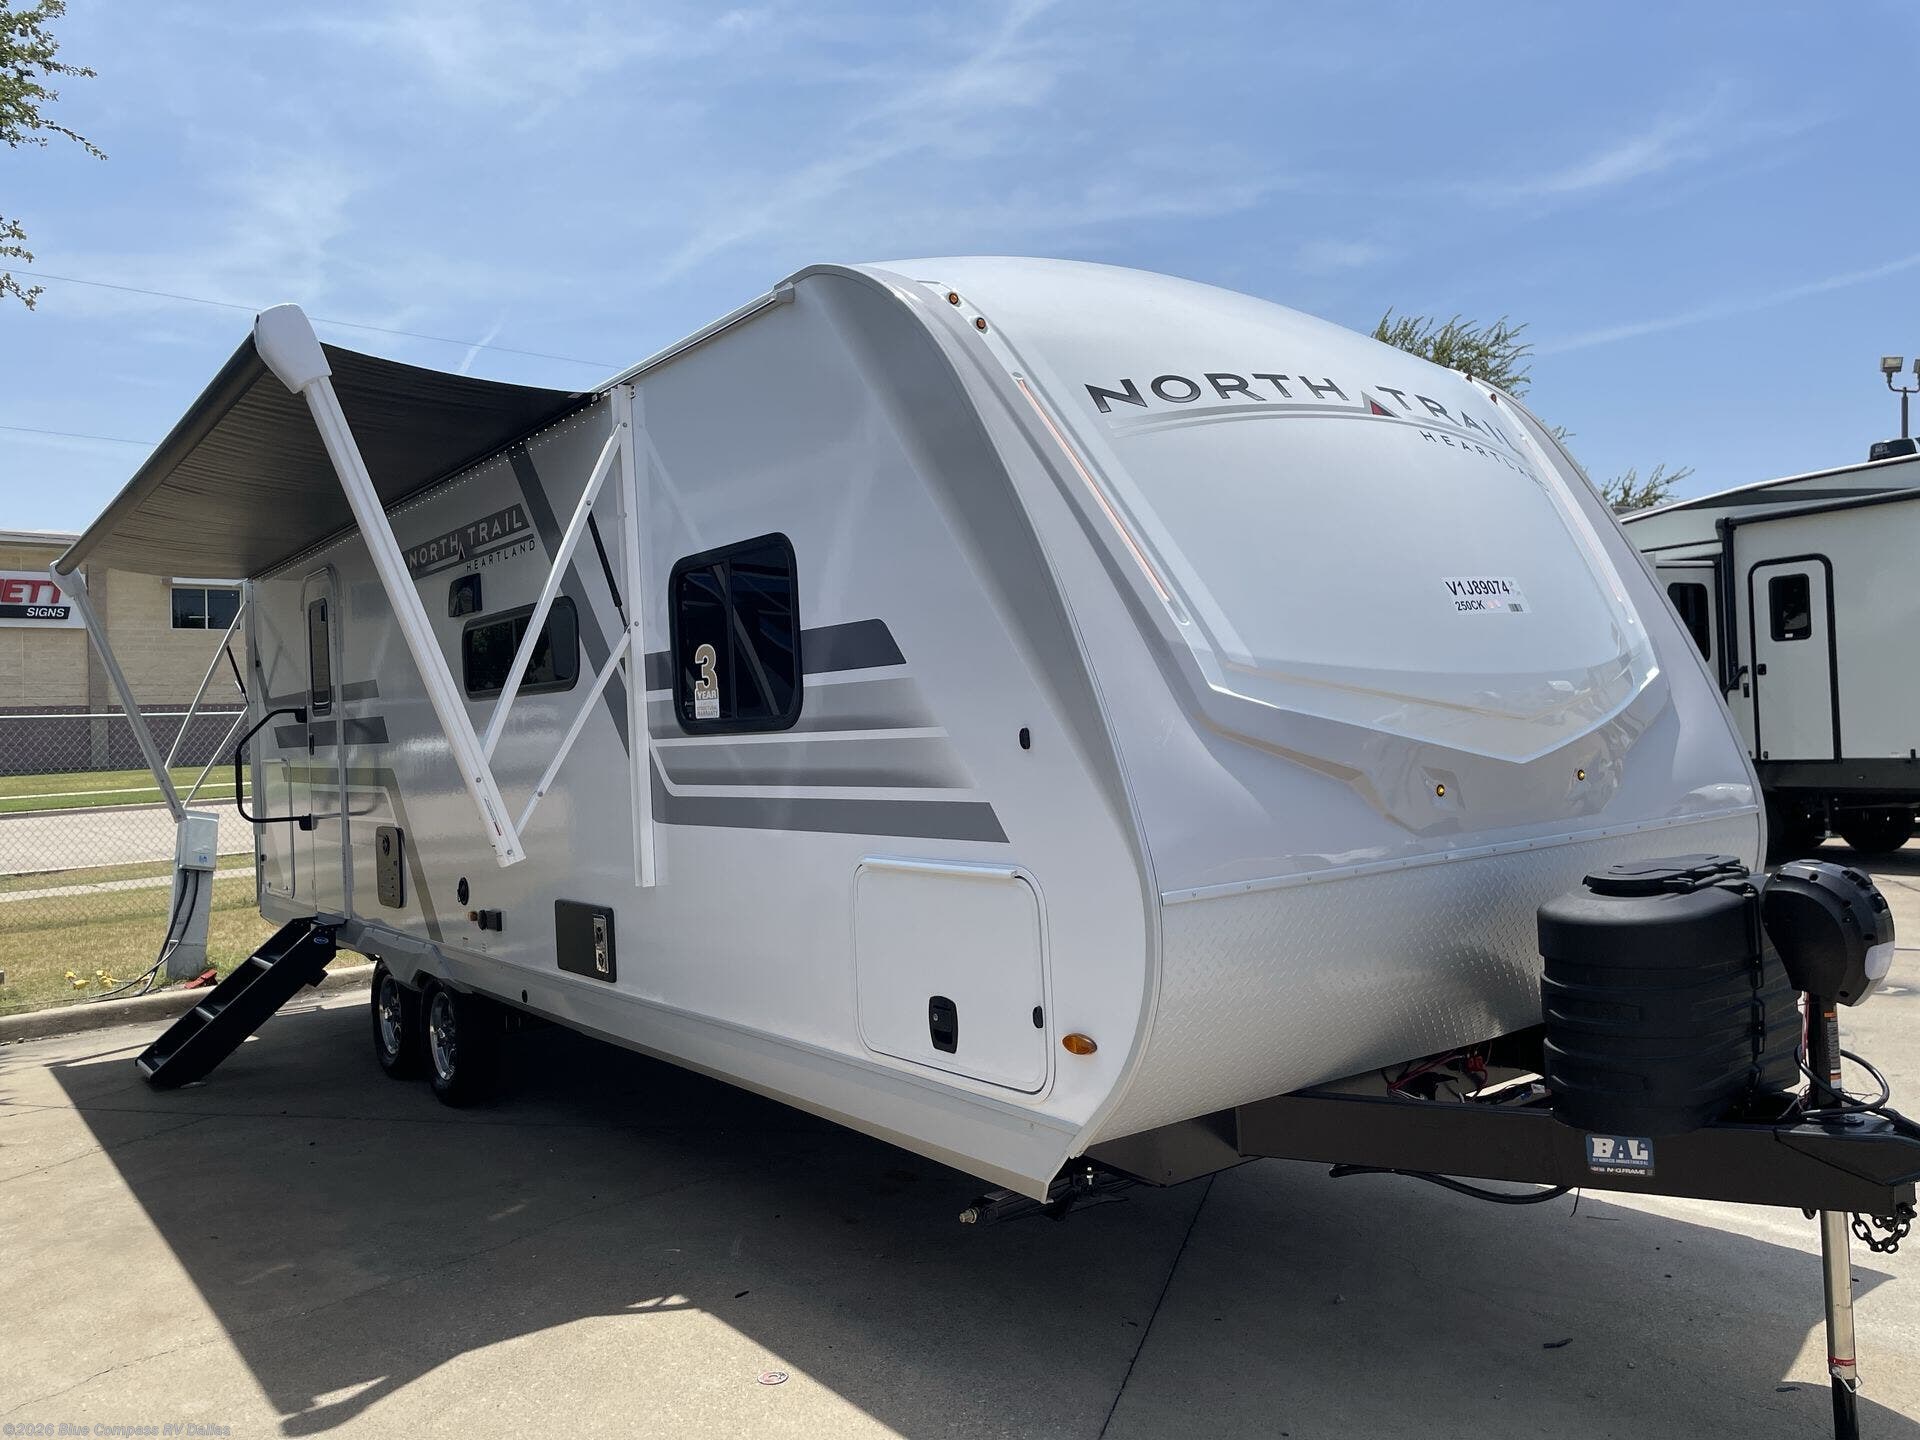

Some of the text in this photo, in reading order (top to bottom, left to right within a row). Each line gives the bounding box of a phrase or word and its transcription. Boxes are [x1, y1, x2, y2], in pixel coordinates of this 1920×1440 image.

[1084, 373, 1529, 462] NORTH TRAIL
[408, 509, 523, 569] NORTH TRAIL
[466, 539, 536, 573] HEARTLAND
[0, 579, 61, 604] ETT
[1445, 580, 1510, 596] V1J89074
[26, 607, 65, 618] SIGNS
[1455, 599, 1486, 611] 250CK
[695, 644, 718, 691] 3
[697, 690, 717, 700] YEAR
[1591, 1137, 1649, 1160] BAL
